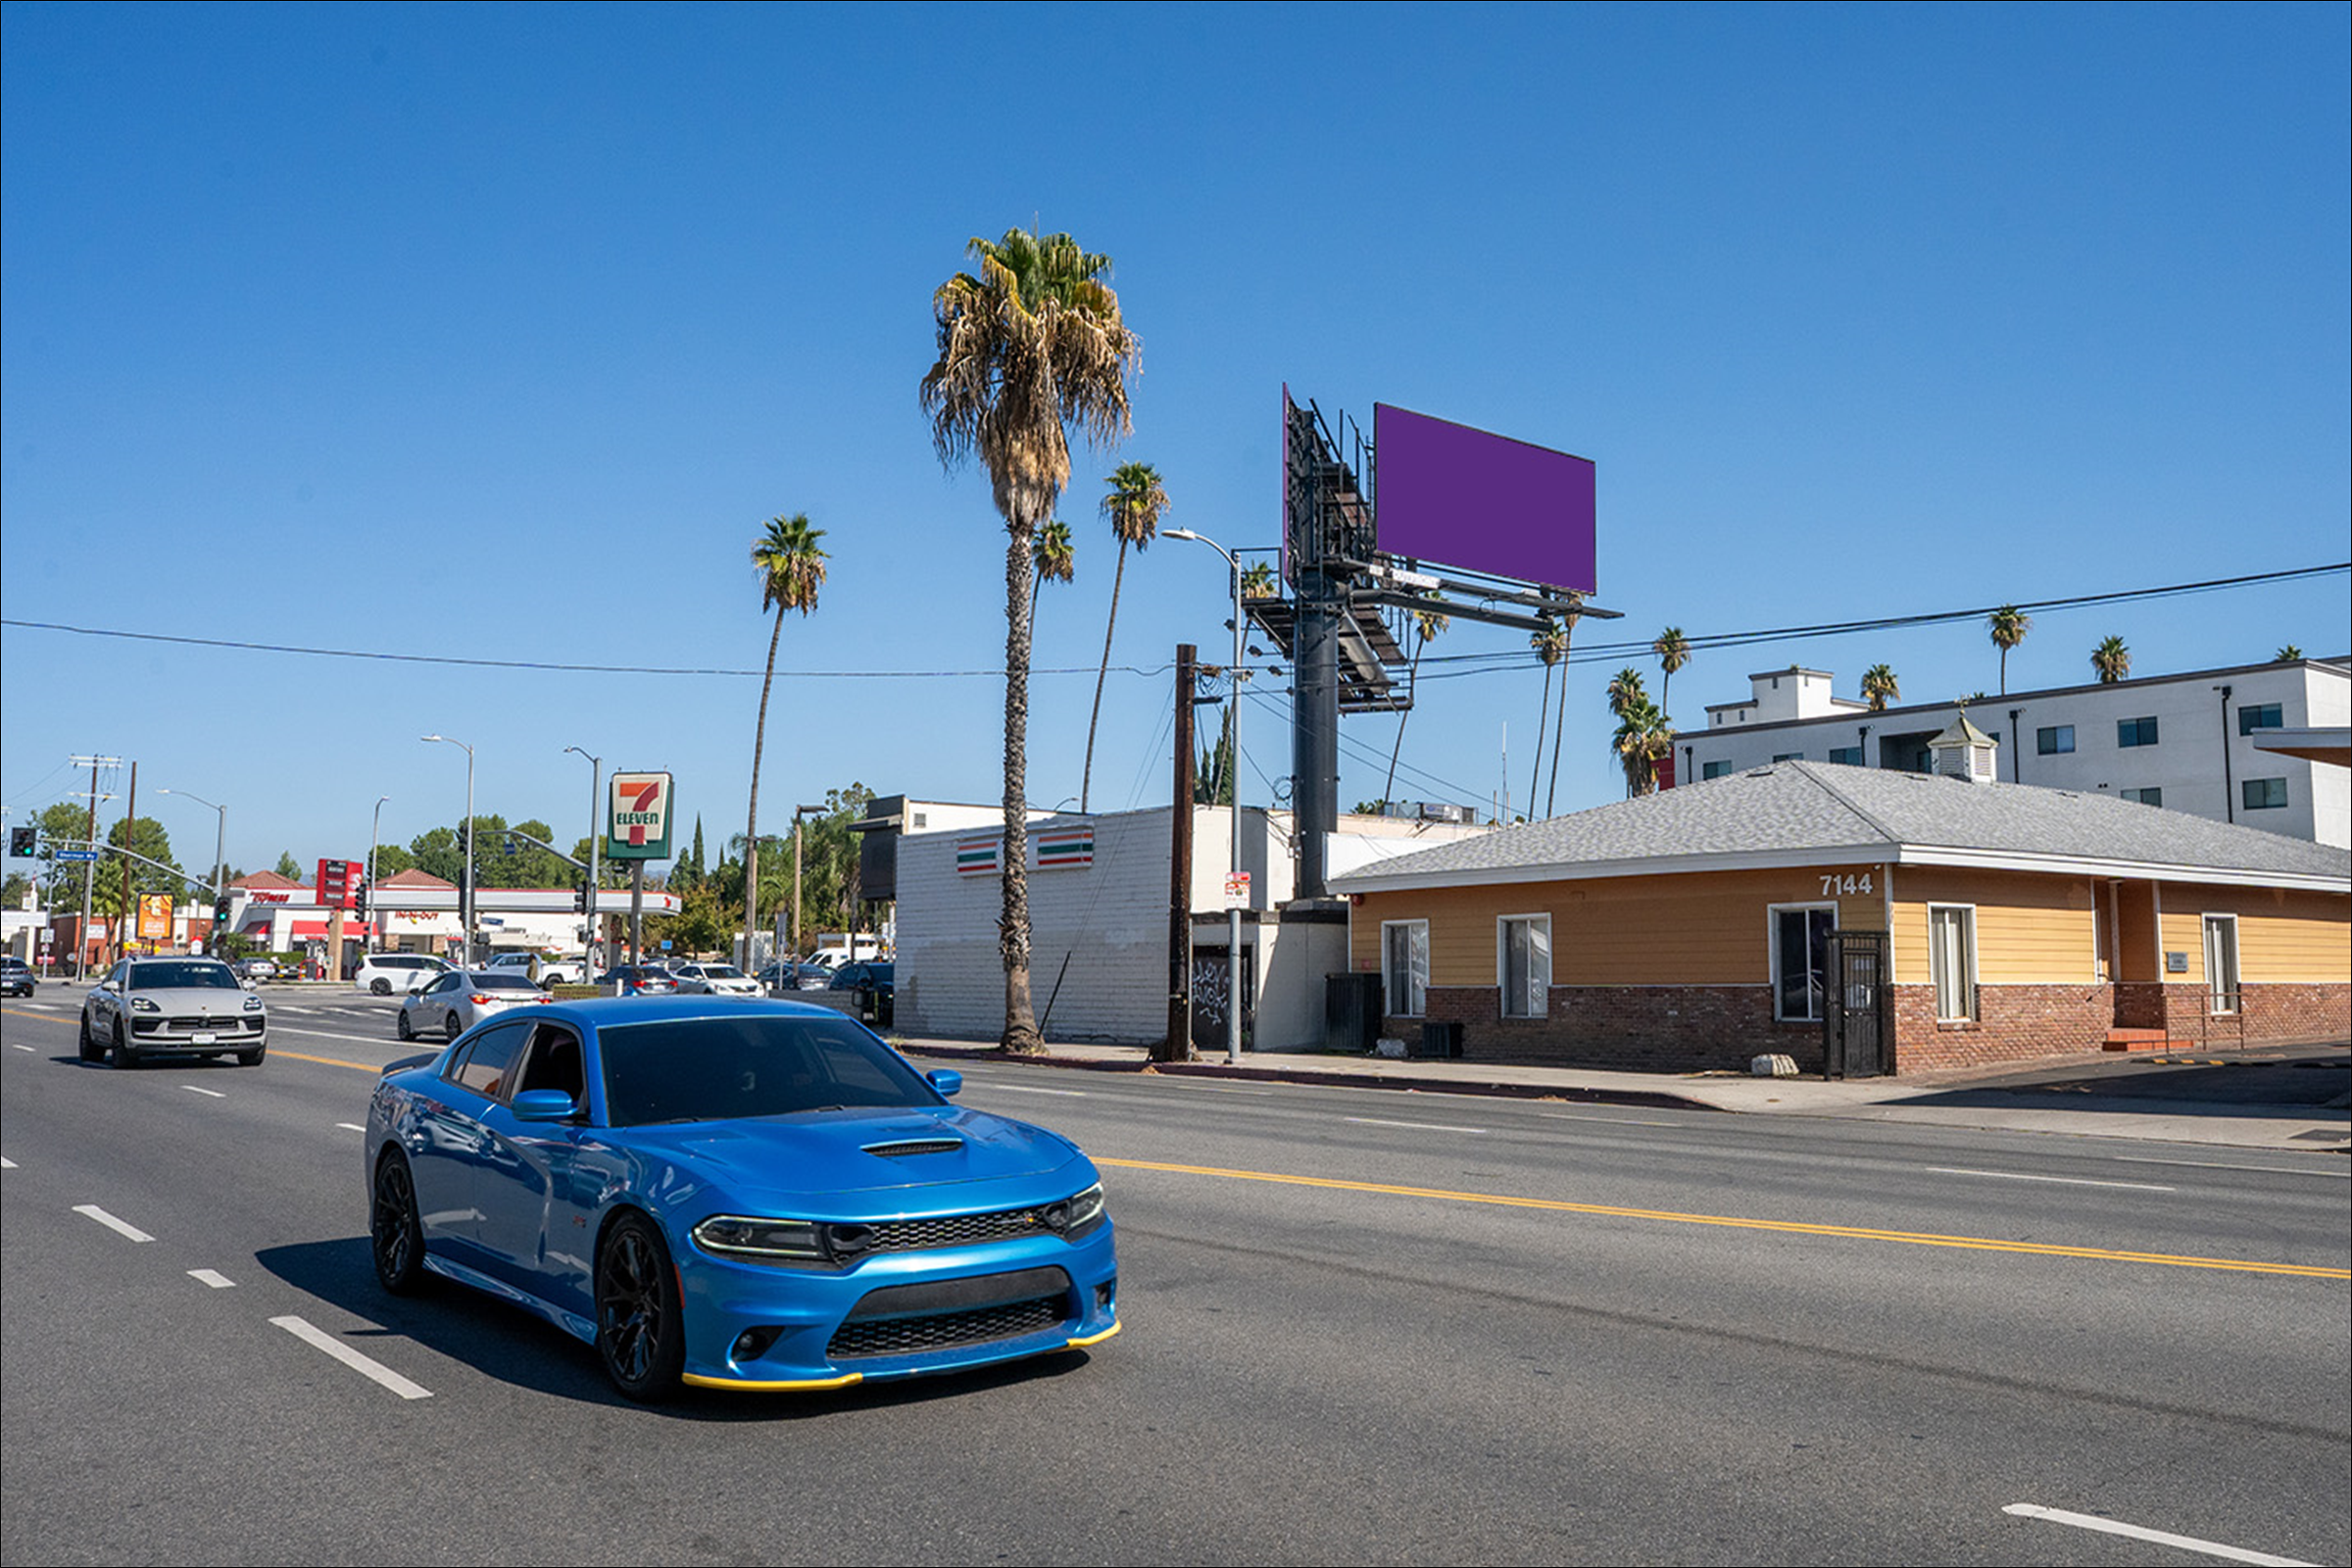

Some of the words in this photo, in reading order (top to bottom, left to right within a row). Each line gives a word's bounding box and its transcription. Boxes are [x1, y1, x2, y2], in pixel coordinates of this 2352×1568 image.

[619, 782, 660, 845] 7
[1819, 873, 1873, 896] 7144
[394, 910, 439, 920] IN-N-OUT
